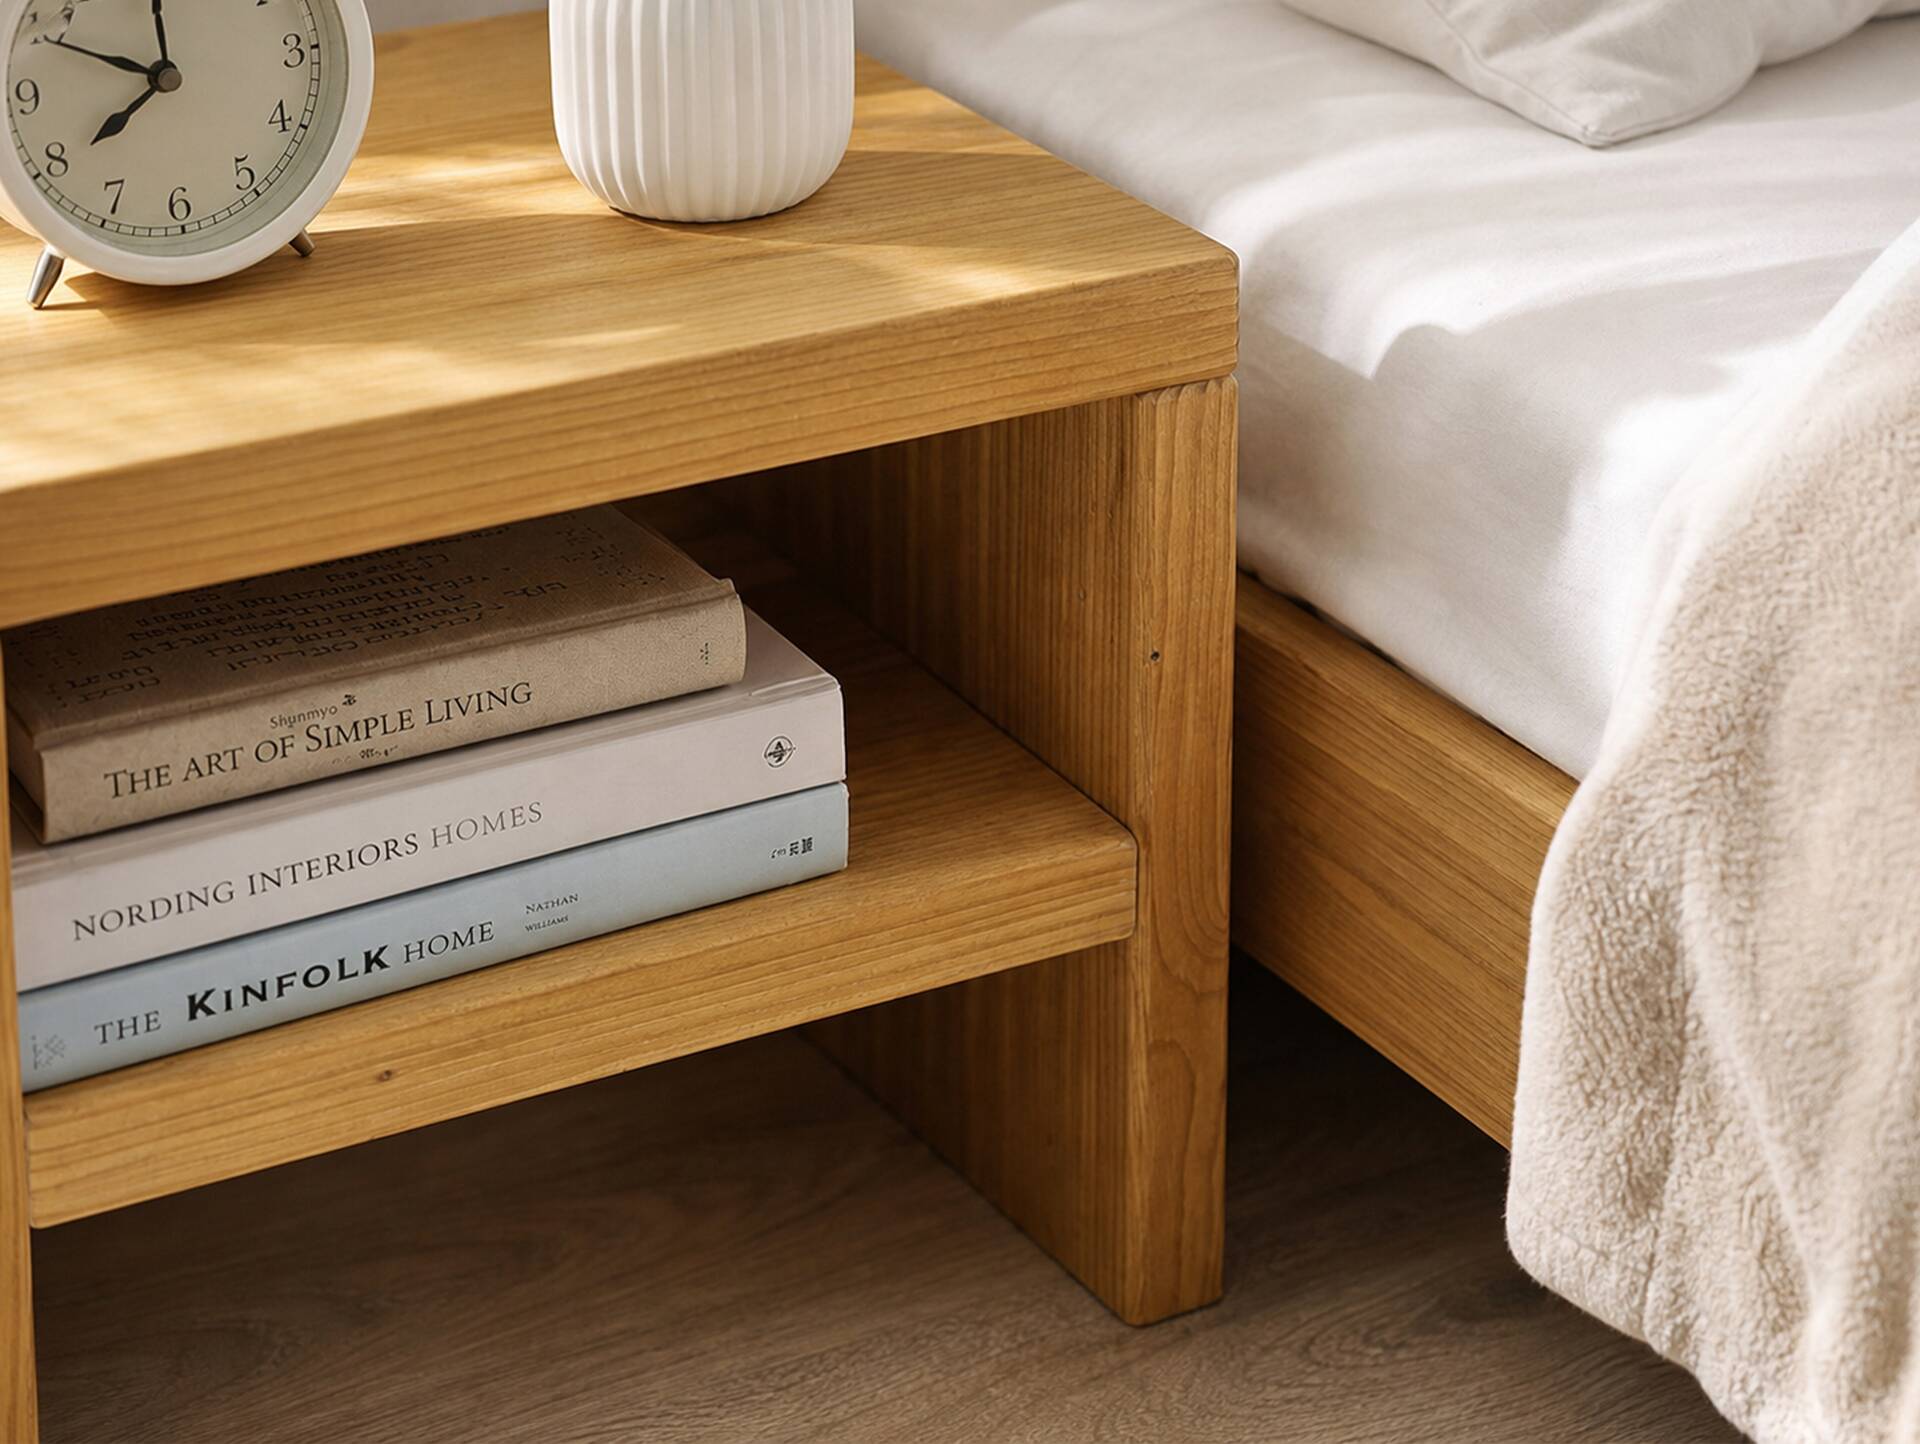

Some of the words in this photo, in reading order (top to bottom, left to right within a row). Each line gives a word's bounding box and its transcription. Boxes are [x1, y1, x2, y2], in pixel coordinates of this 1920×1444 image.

[282, 33, 305, 68] 3
[15, 79, 40, 115] 9
[268, 99, 292, 133] 4
[45, 142, 69, 177] 8
[233, 154, 256, 191] 5
[103, 179, 125, 215] 7
[168, 186, 192, 221] 6
[104, 764, 172, 799] THE
[183, 747, 244, 782] ART
[254, 735, 295, 763] OF
[305, 709, 415, 752] SIMPLE
[425, 682, 532, 726] LIVING
[73, 879, 235, 942] NORDING
[247, 832, 419, 896] INTERIORS
[431, 801, 543, 849] HOMES
[525, 892, 579, 914] NATHAN
[94, 1010, 161, 1044] THE
[186, 944, 391, 1022] KINFOLK
[403, 920, 495, 965] HOME
